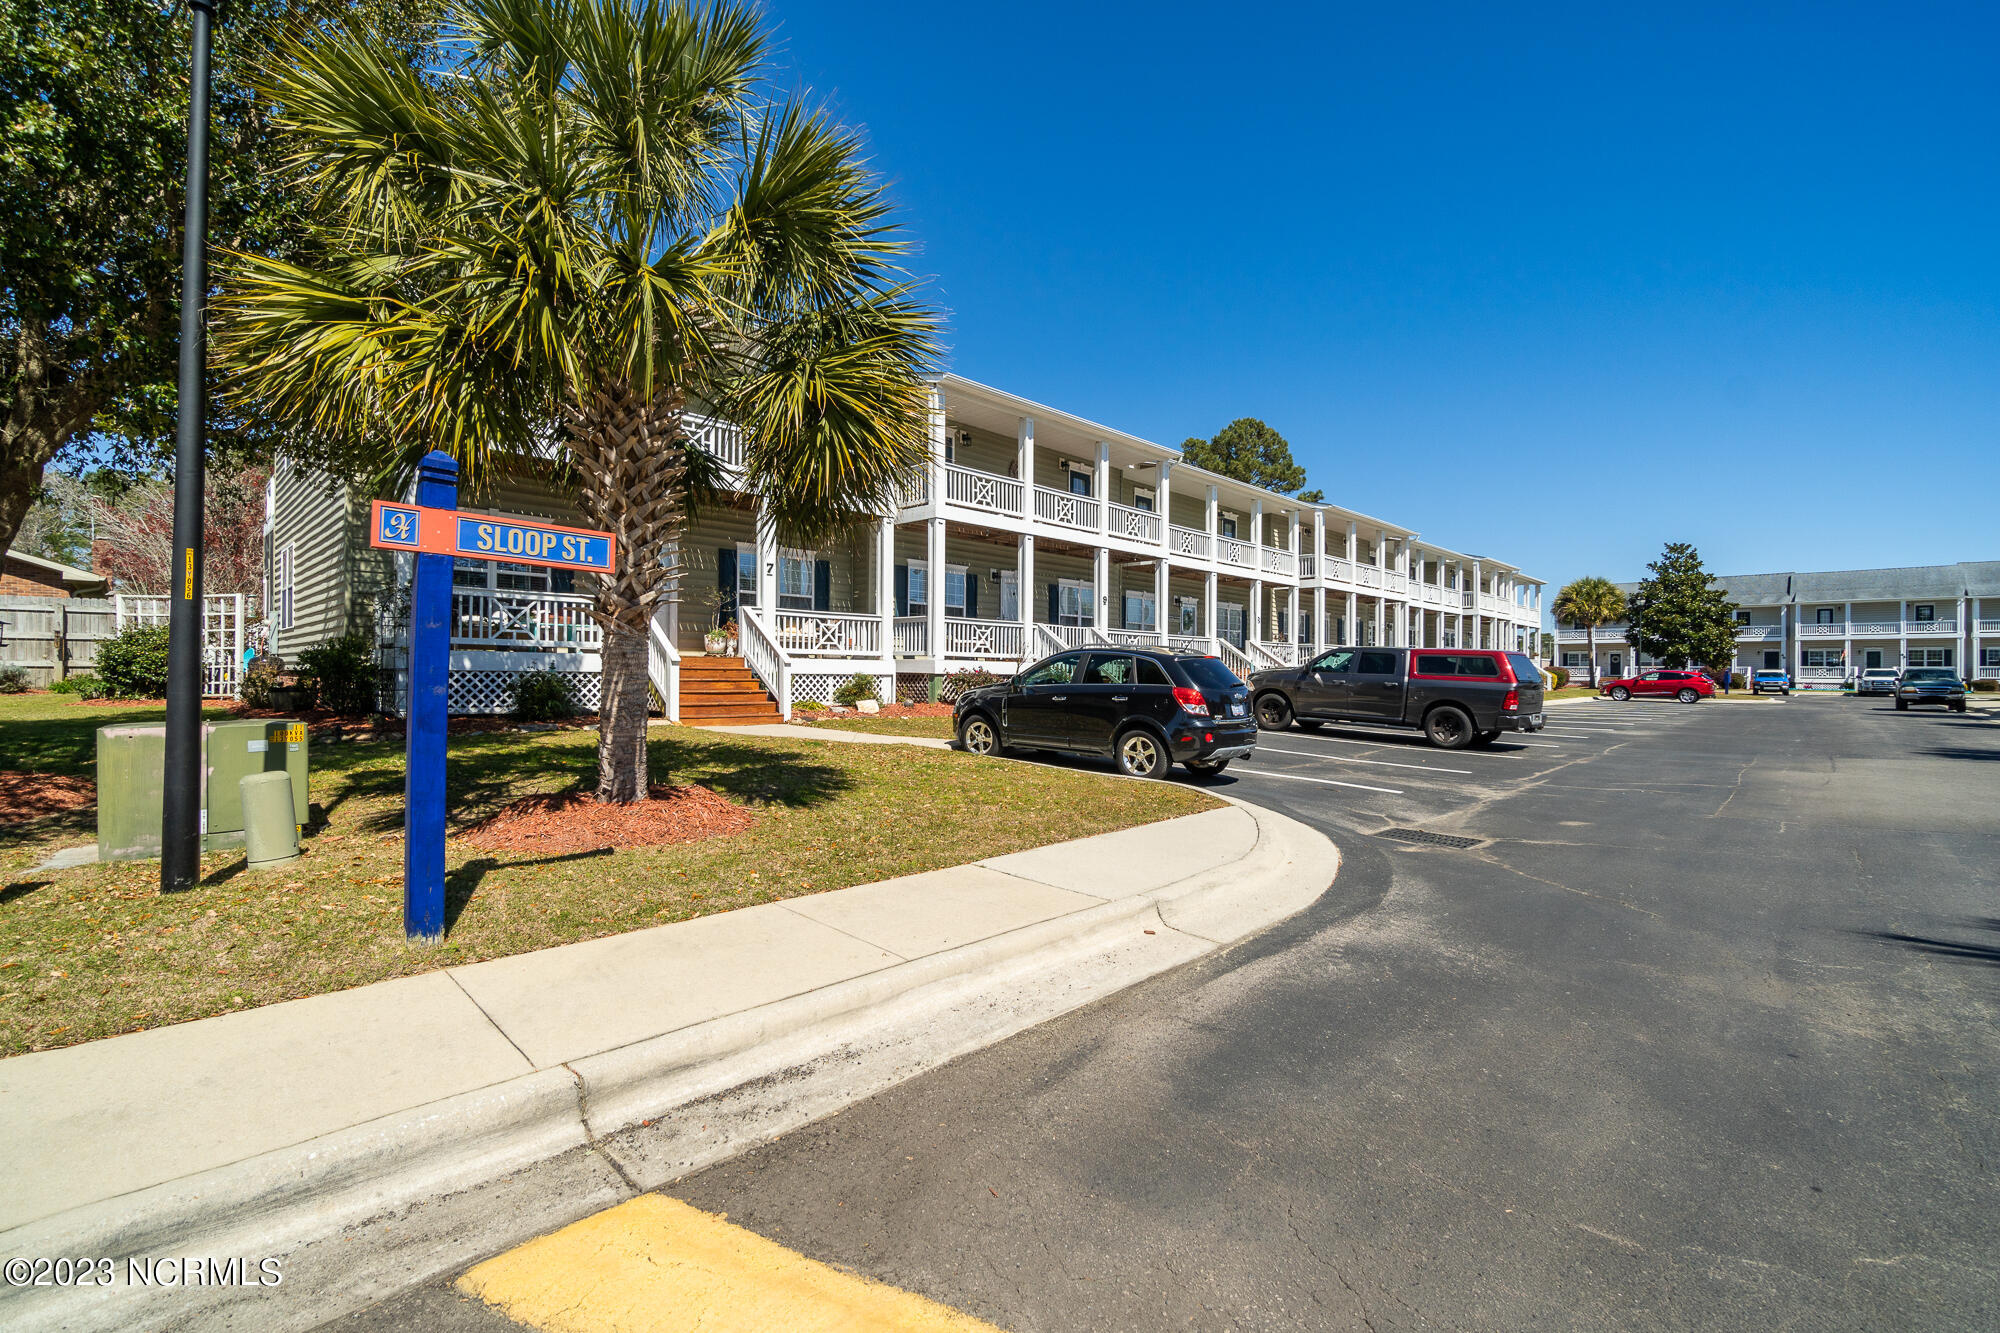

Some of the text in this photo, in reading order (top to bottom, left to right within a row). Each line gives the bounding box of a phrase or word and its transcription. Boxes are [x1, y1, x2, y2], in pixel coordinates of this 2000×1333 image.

[477, 524, 593, 563] SLOOP ST.
[767, 562, 774, 575] 7
